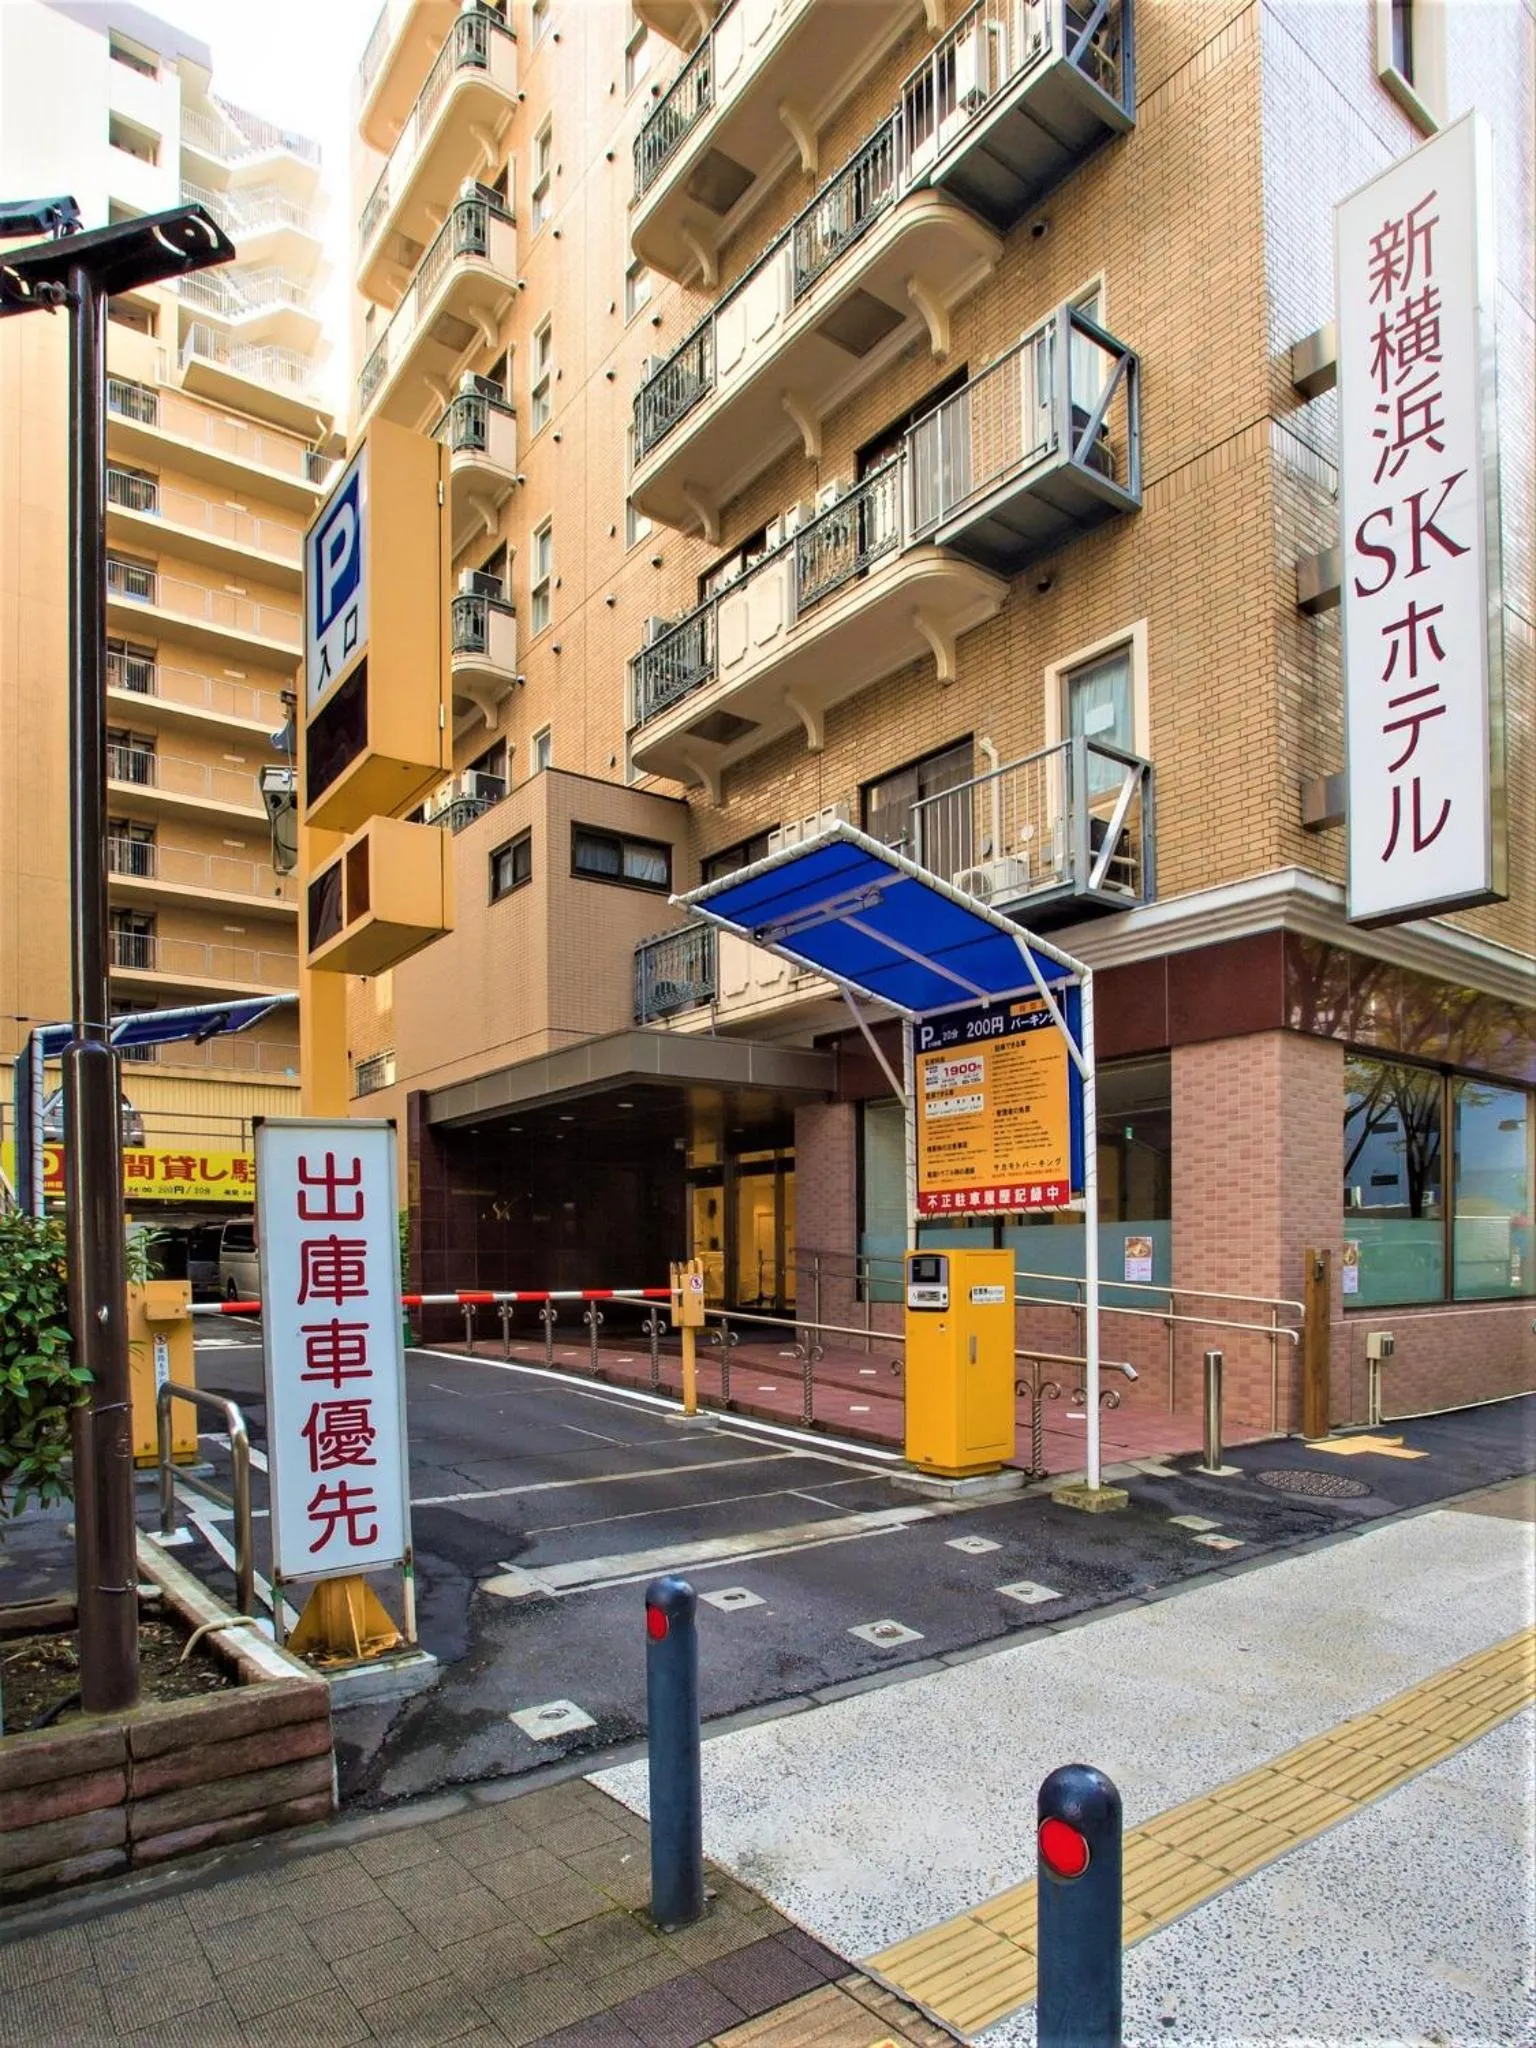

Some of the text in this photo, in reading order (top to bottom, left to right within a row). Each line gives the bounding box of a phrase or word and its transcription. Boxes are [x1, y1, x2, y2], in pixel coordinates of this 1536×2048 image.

[321, 501, 356, 625] P
[1355, 189, 1472, 863] 新横浜SKホテル
[317, 602, 358, 691] 入口
[921, 1026, 935, 1050] P
[965, 1016, 1004, 1038] 200円
[297, 1151, 378, 1554] 出庫車優先
